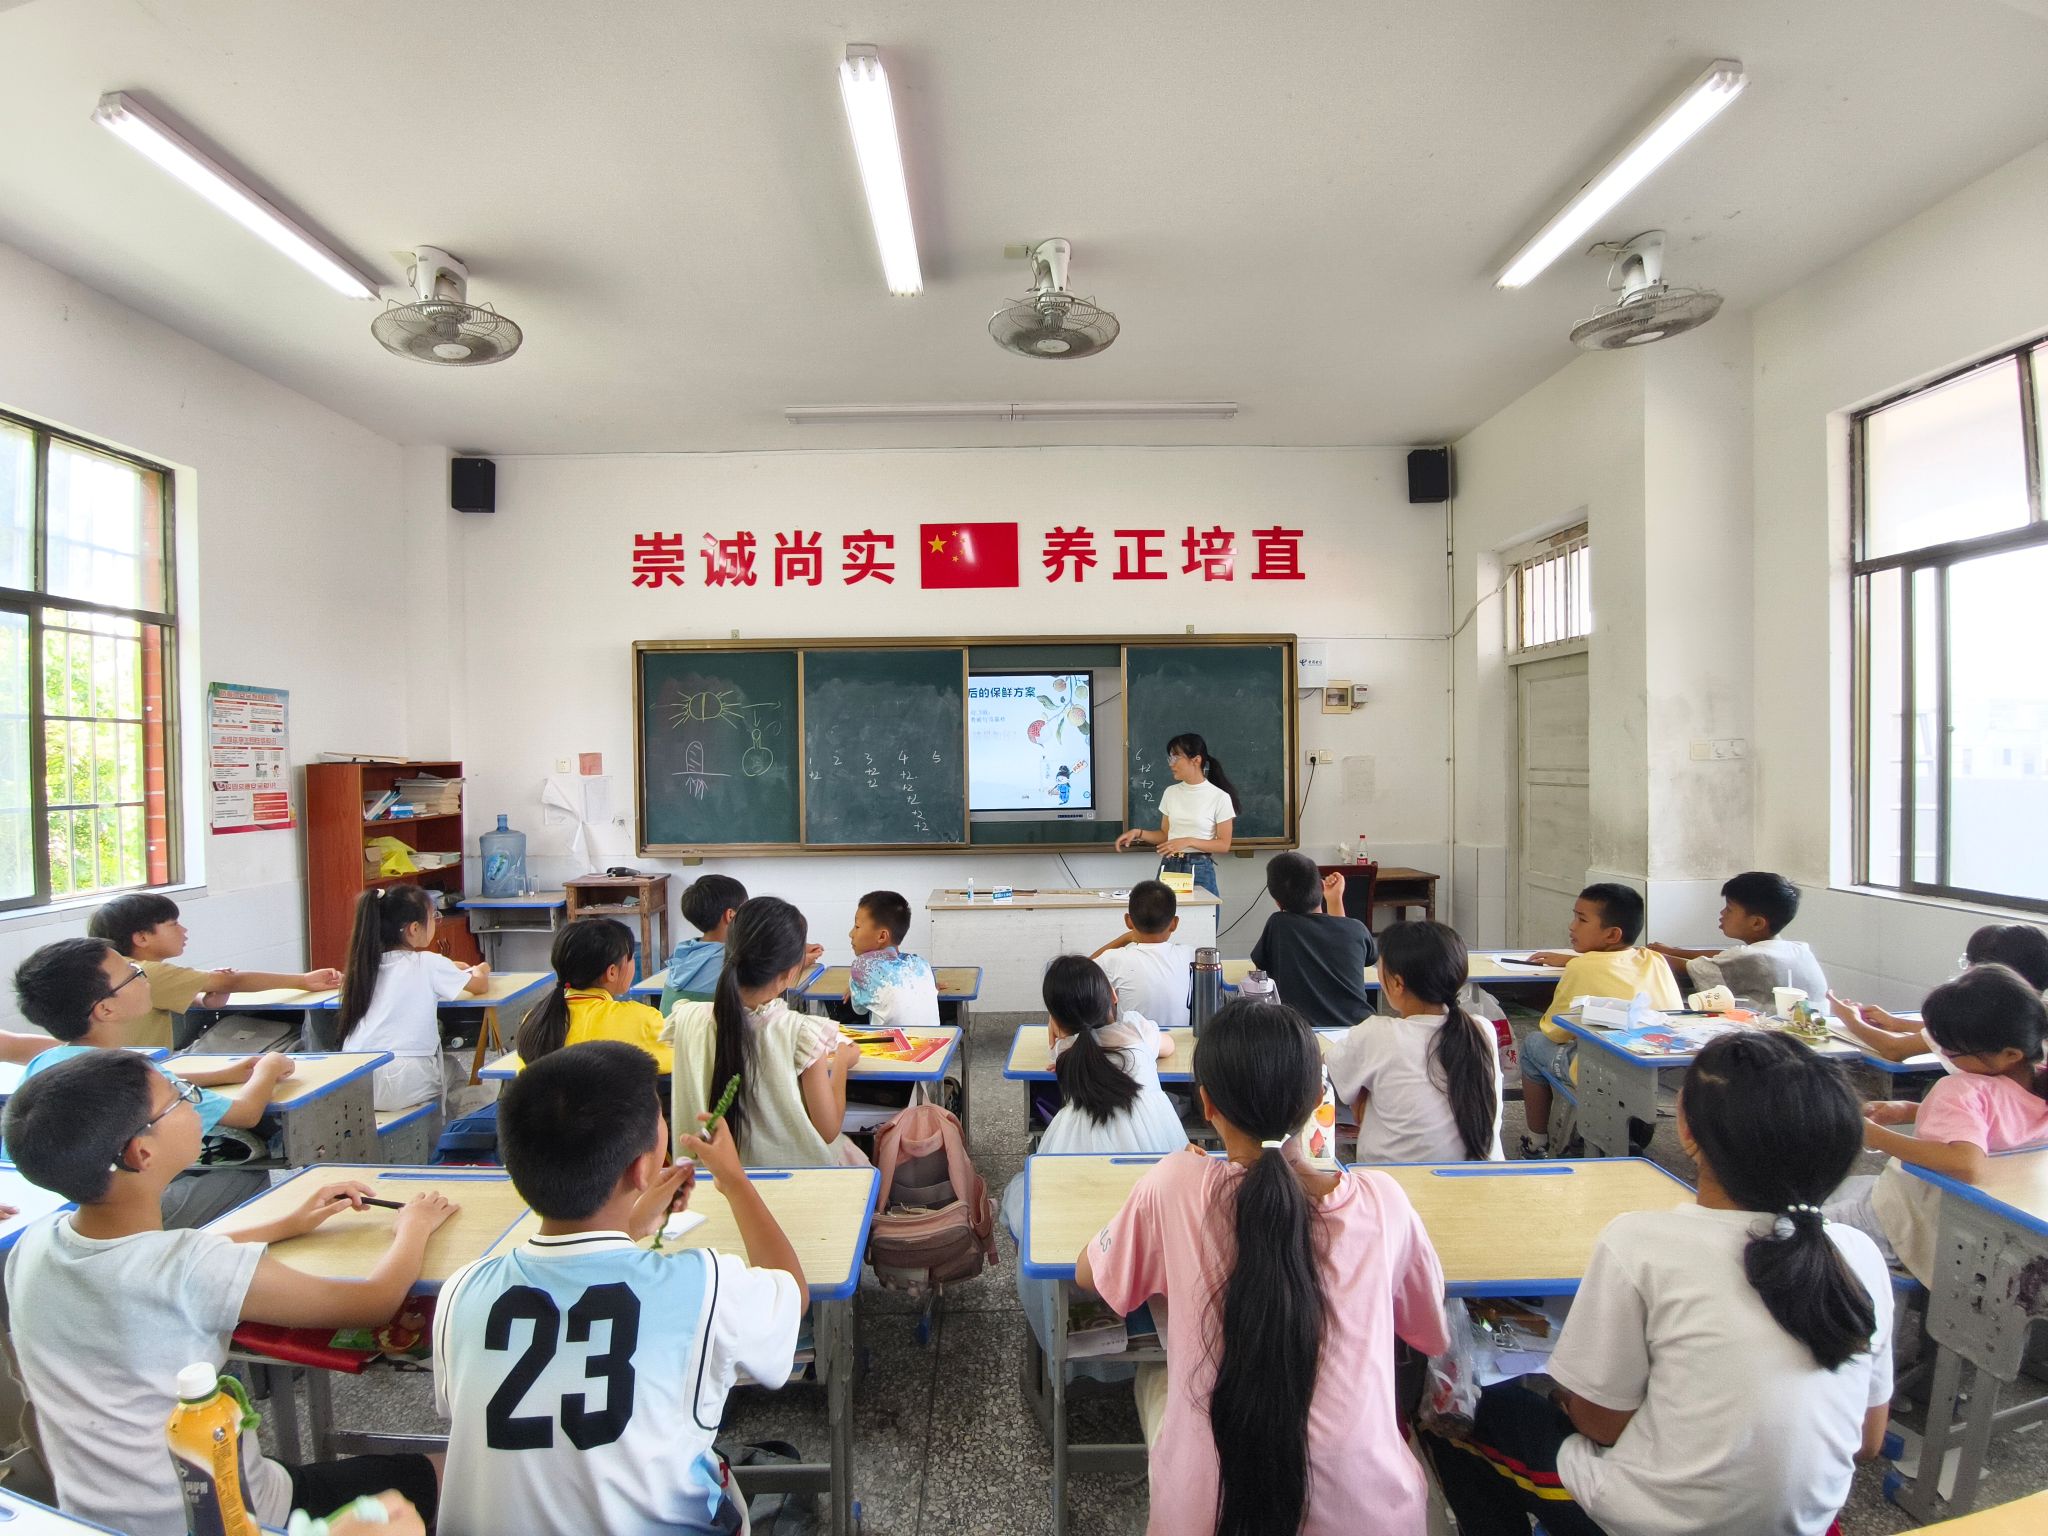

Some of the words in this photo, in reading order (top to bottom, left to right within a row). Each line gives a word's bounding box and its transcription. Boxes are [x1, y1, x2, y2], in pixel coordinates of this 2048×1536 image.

[632, 529, 896, 588] 崇诚尚实
[1042, 526, 1306, 583] 养正培直
[968, 686, 1036, 698] 后的保鲜方案
[833, 755, 842, 765] 2
[864, 753, 873, 765] 3
[898, 750, 909, 765] 4
[932, 750, 942, 764] 5
[1135, 748, 1143, 761] 6
[864, 767, 880, 776] +2
[1138, 763, 1151, 773] +2
[809, 771, 822, 780] +2
[867, 779, 879, 788] +2
[902, 784, 914, 792] +2
[906, 793, 920, 805] +2
[1143, 792, 1155, 802] +2
[911, 810, 926, 820] +2
[914, 821, 929, 832] +2
[485, 1281, 641, 1451] 23
